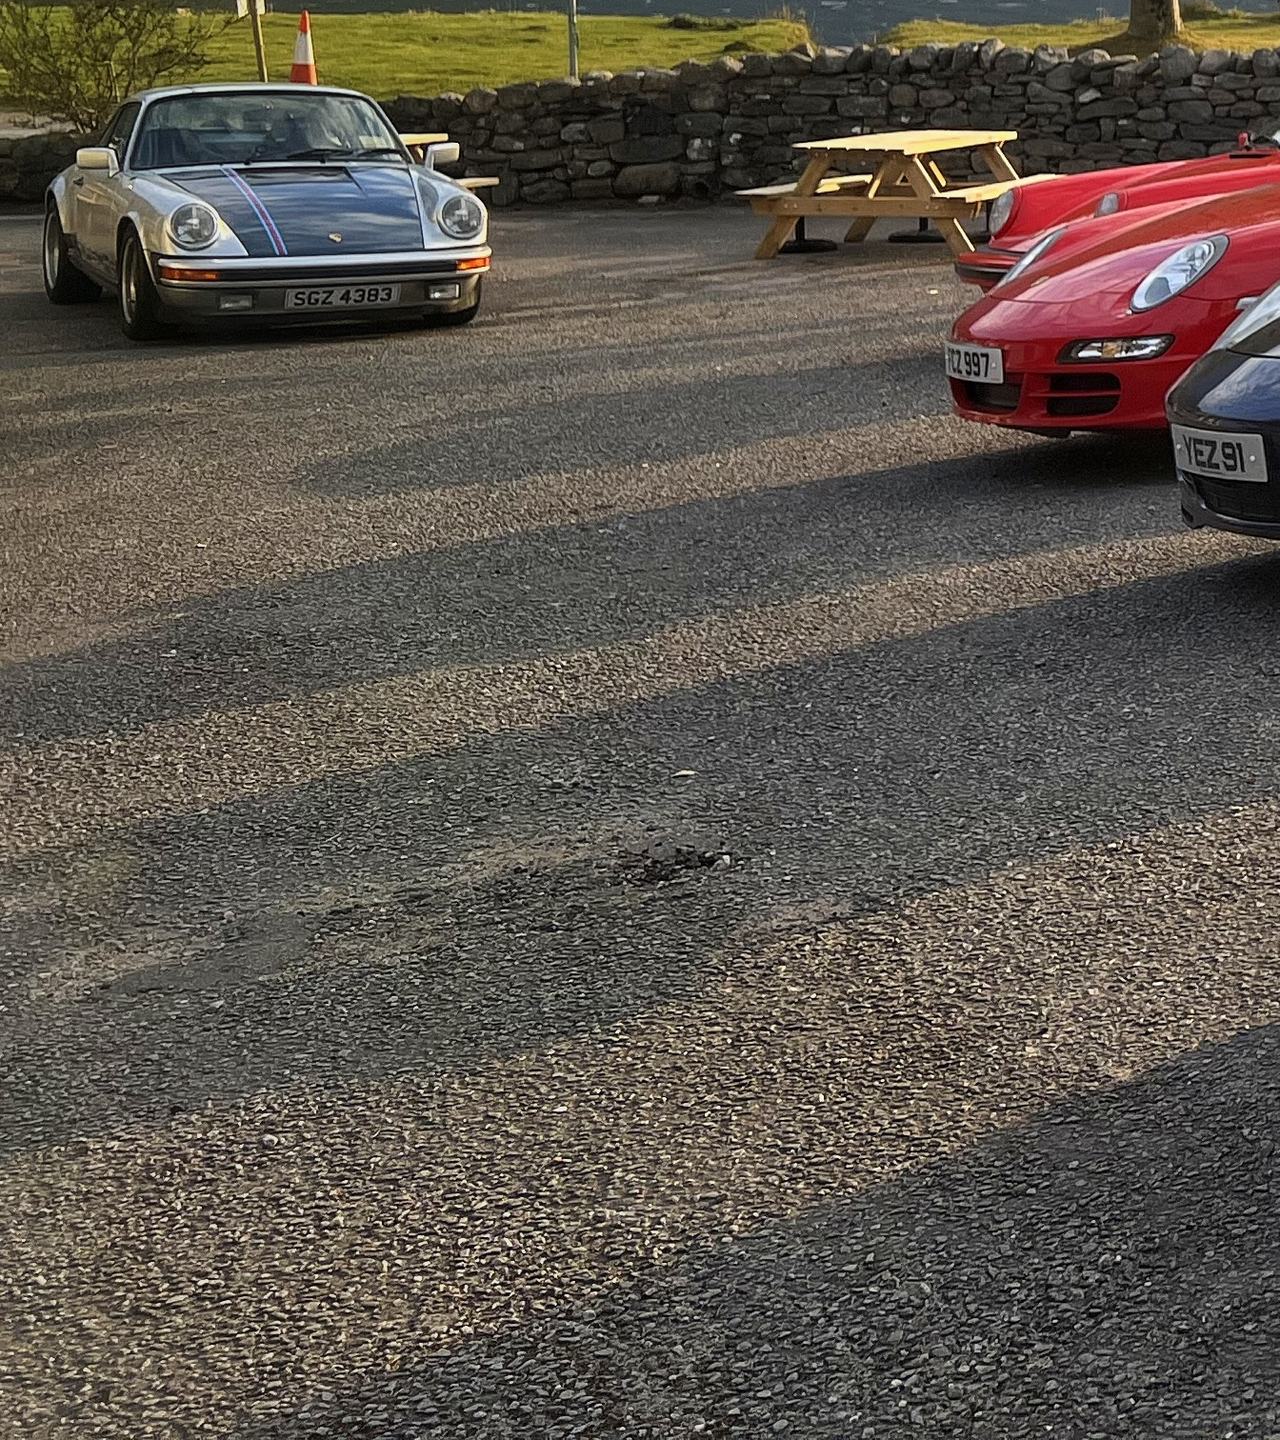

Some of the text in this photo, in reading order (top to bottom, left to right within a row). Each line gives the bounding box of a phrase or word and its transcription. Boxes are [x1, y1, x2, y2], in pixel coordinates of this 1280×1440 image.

[293, 287, 393, 307] SGZ 4383
[963, 351, 990, 378] 997
[1182, 433, 1246, 473] YEZ 91
